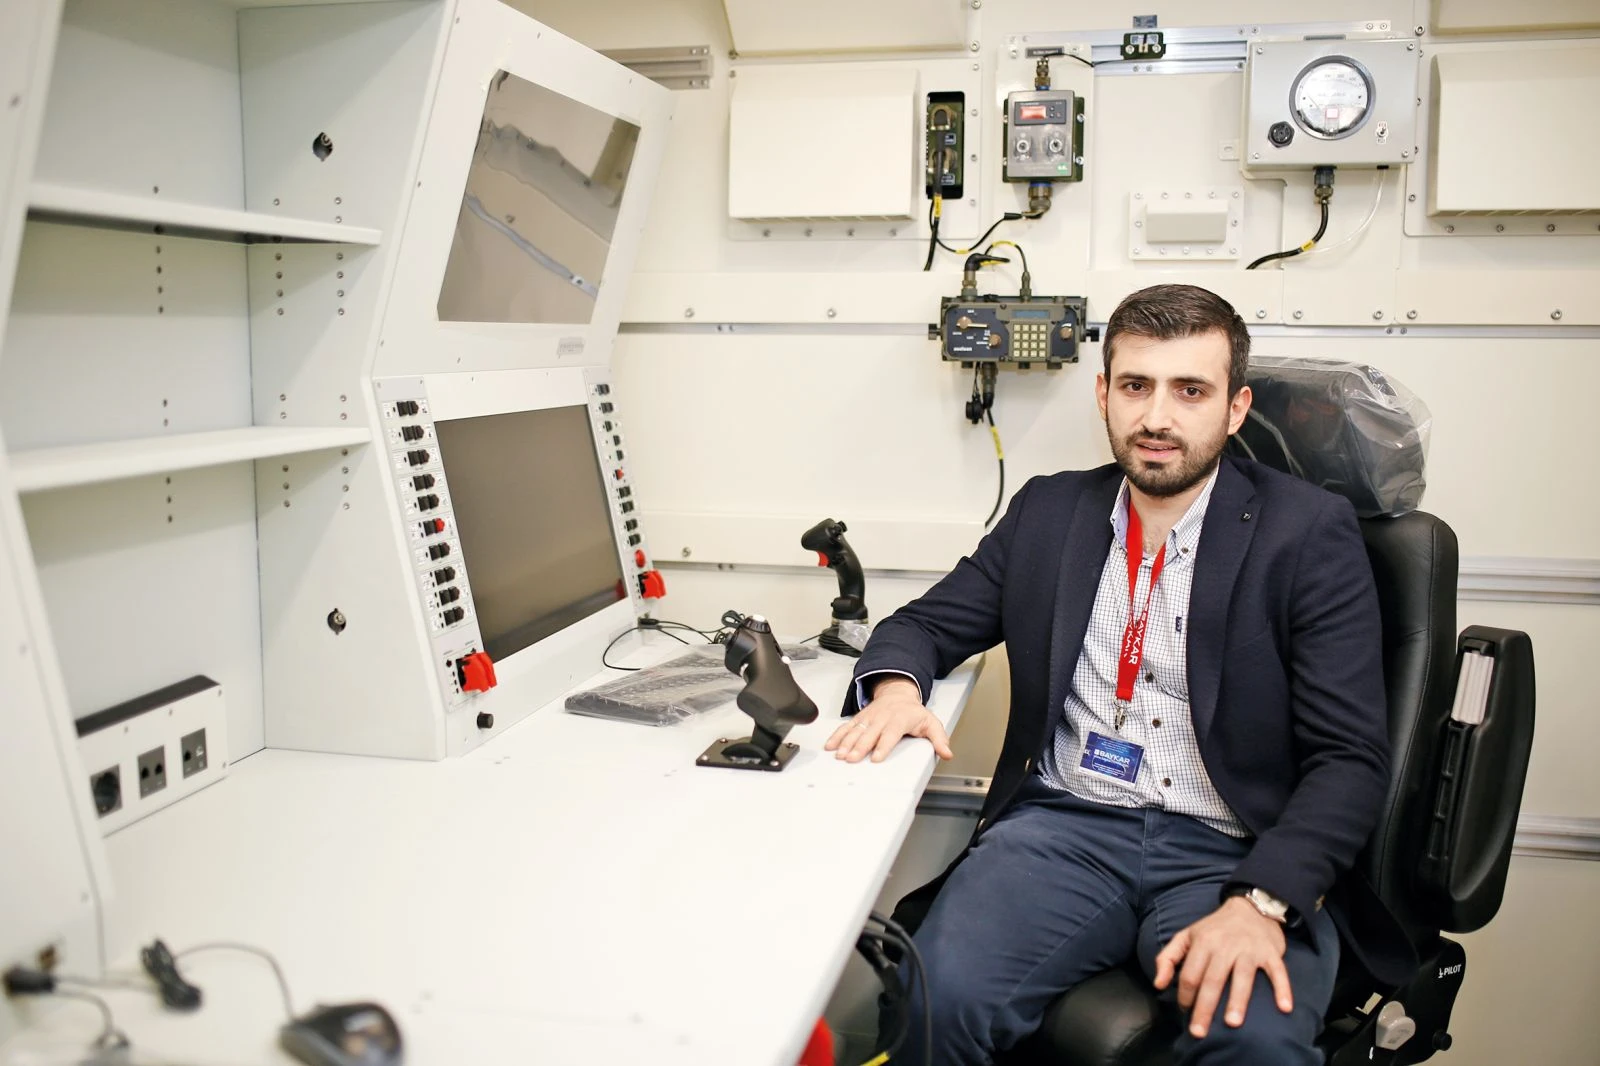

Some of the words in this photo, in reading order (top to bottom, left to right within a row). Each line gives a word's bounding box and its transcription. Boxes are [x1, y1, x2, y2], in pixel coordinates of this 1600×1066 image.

[1128, 612, 1147, 665] BAYKAR
[1099, 749, 1131, 765] BAYKAR
[1443, 963, 1462, 975] PILOT
